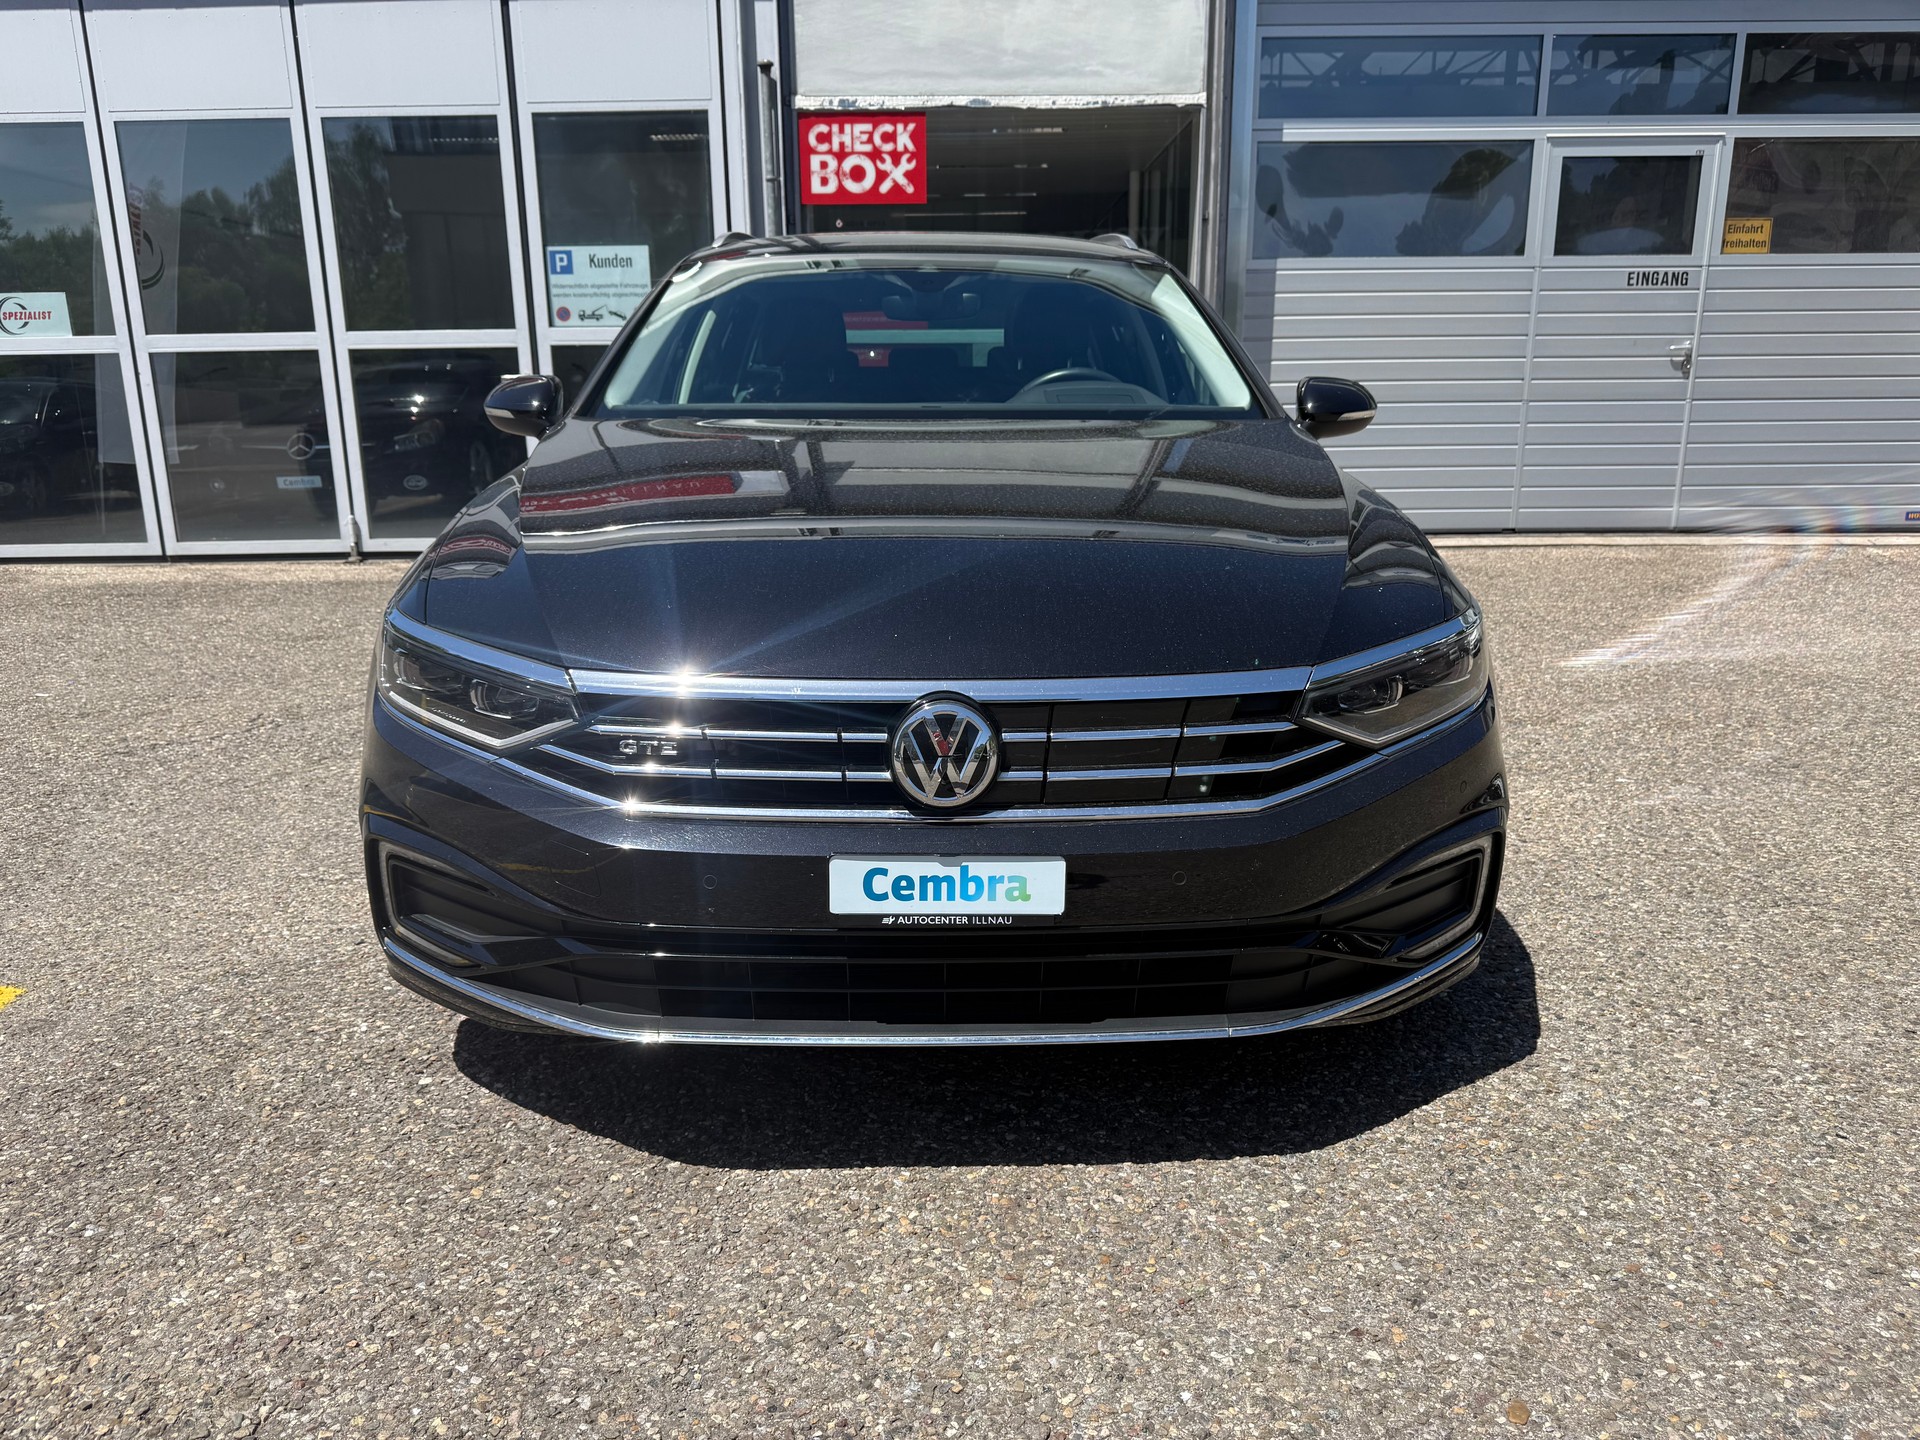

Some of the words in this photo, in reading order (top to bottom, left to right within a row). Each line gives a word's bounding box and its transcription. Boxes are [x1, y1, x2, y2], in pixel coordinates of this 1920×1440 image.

[808, 123, 917, 152] CHECK
[810, 153, 917, 194] BOX
[1727, 223, 1764, 234] Einfahrt
[555, 254, 568, 273] P
[588, 253, 633, 269] Kunden
[1627, 271, 1689, 287] EINGANG
[2, 311, 52, 321] SPEZIALIST
[619, 739, 678, 756] GTE
[862, 865, 1031, 902] Cembra
[897, 916, 969, 925] AUTOCENTER
[972, 916, 1012, 925] ILLNAU
